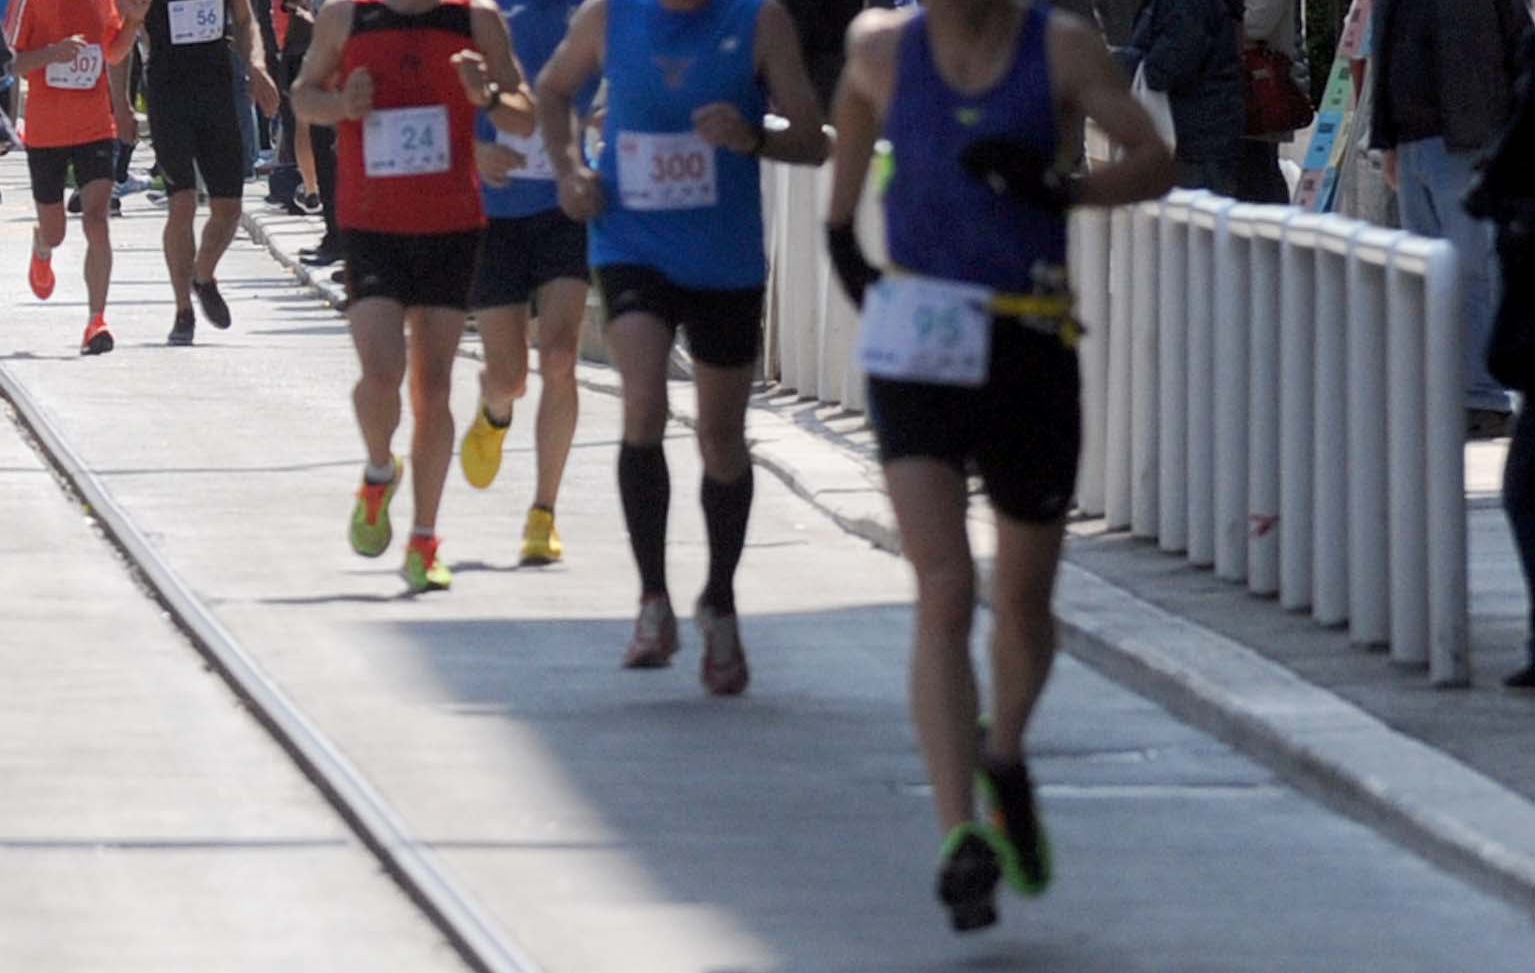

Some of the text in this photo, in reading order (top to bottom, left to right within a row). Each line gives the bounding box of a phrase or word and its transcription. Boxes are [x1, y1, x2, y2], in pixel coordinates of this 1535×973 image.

[197, 8, 216, 25] 56
[401, 125, 434, 149] 24
[649, 153, 705, 183] 300
